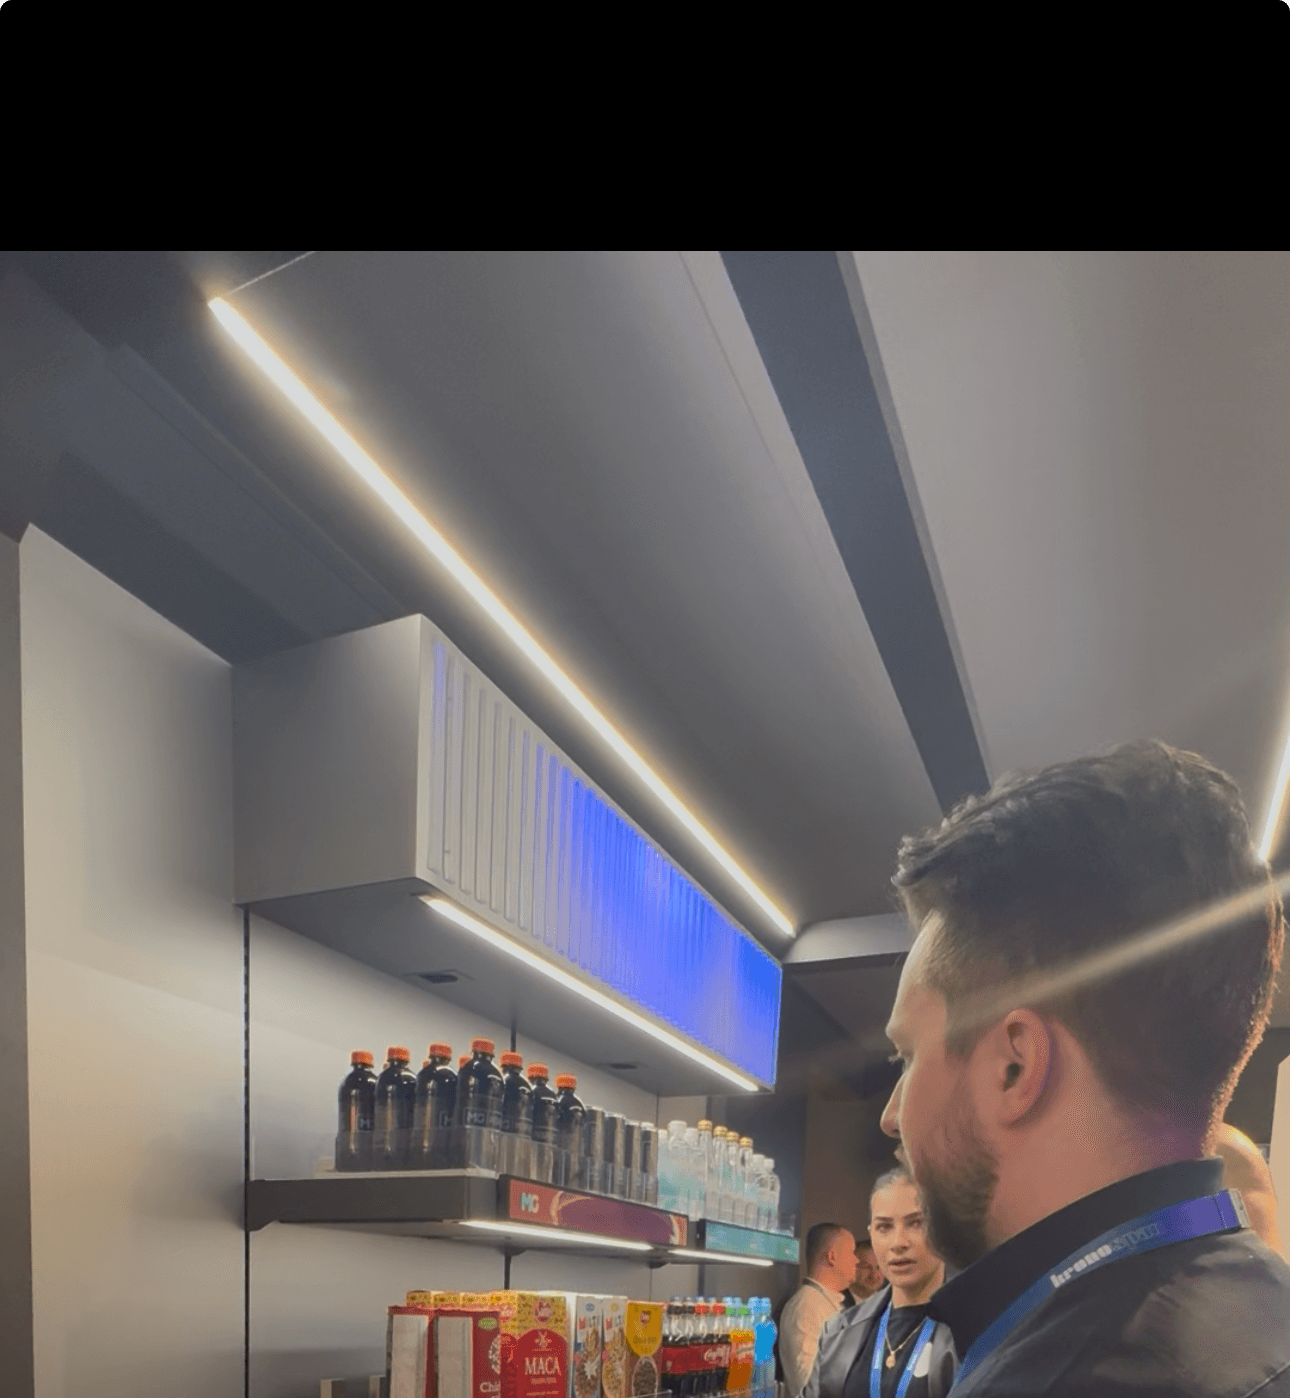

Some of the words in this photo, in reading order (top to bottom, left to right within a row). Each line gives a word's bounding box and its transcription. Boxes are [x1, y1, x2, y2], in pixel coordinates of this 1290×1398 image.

[466, 1110, 487, 1124] MG
[519, 1192, 540, 1213] MG
[525, 1356, 562, 1376] MACA
